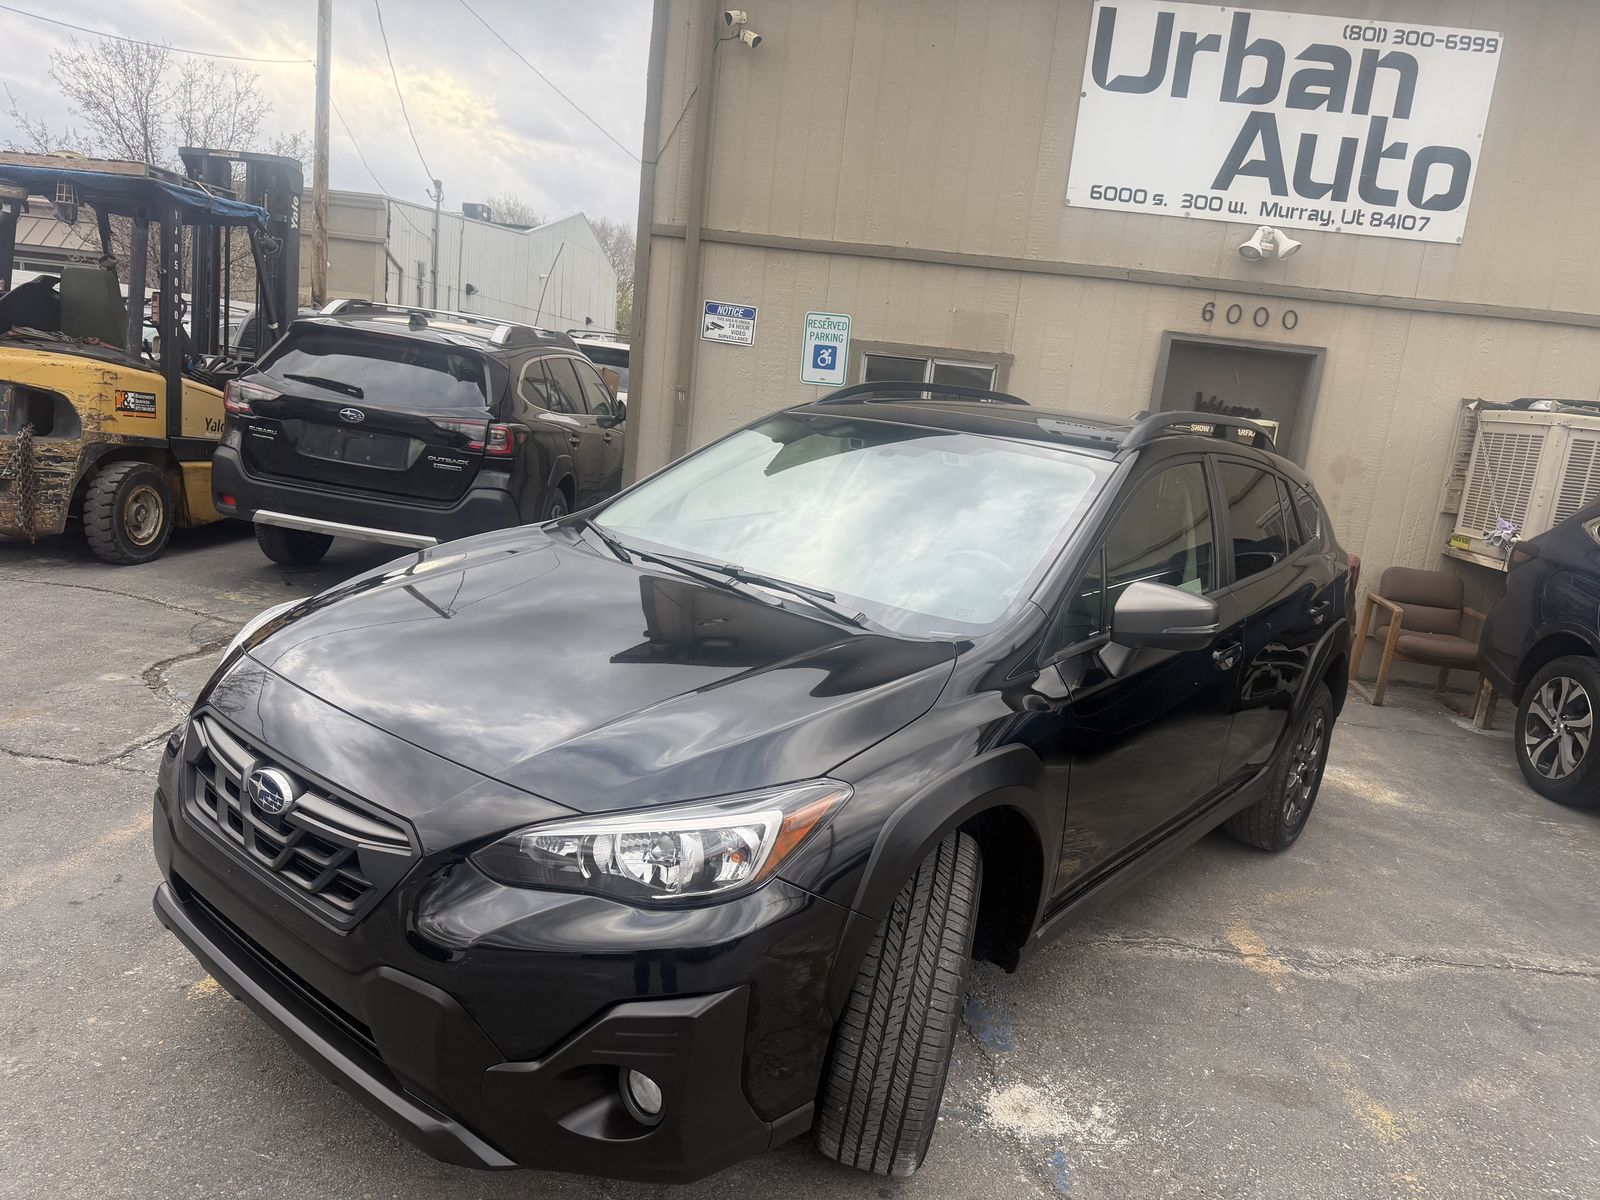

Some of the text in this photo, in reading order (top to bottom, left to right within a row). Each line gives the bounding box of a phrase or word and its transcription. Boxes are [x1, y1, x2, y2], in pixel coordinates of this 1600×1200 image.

[1342, 24, 1499, 54] (801) 300-6999
[1091, 5, 1420, 120] Urban
[1210, 110, 1472, 212] Auto
[290, 195, 299, 229] Yale
[1090, 184, 1148, 204] 6000
[1180, 193, 1224, 212] 300
[1259, 200, 1336, 227] Murray,
[1369, 211, 1431, 232] 84107
[717, 305, 745, 317] NOTICE
[1201, 301, 1299, 330] 6000
[808, 319, 848, 331] RESERVED
[718, 333, 748, 342] SURVEILLANCE
[810, 331, 844, 343] PARKING
[249, 425, 278, 435] SUBARU
[427, 455, 469, 466] OUTBACK
